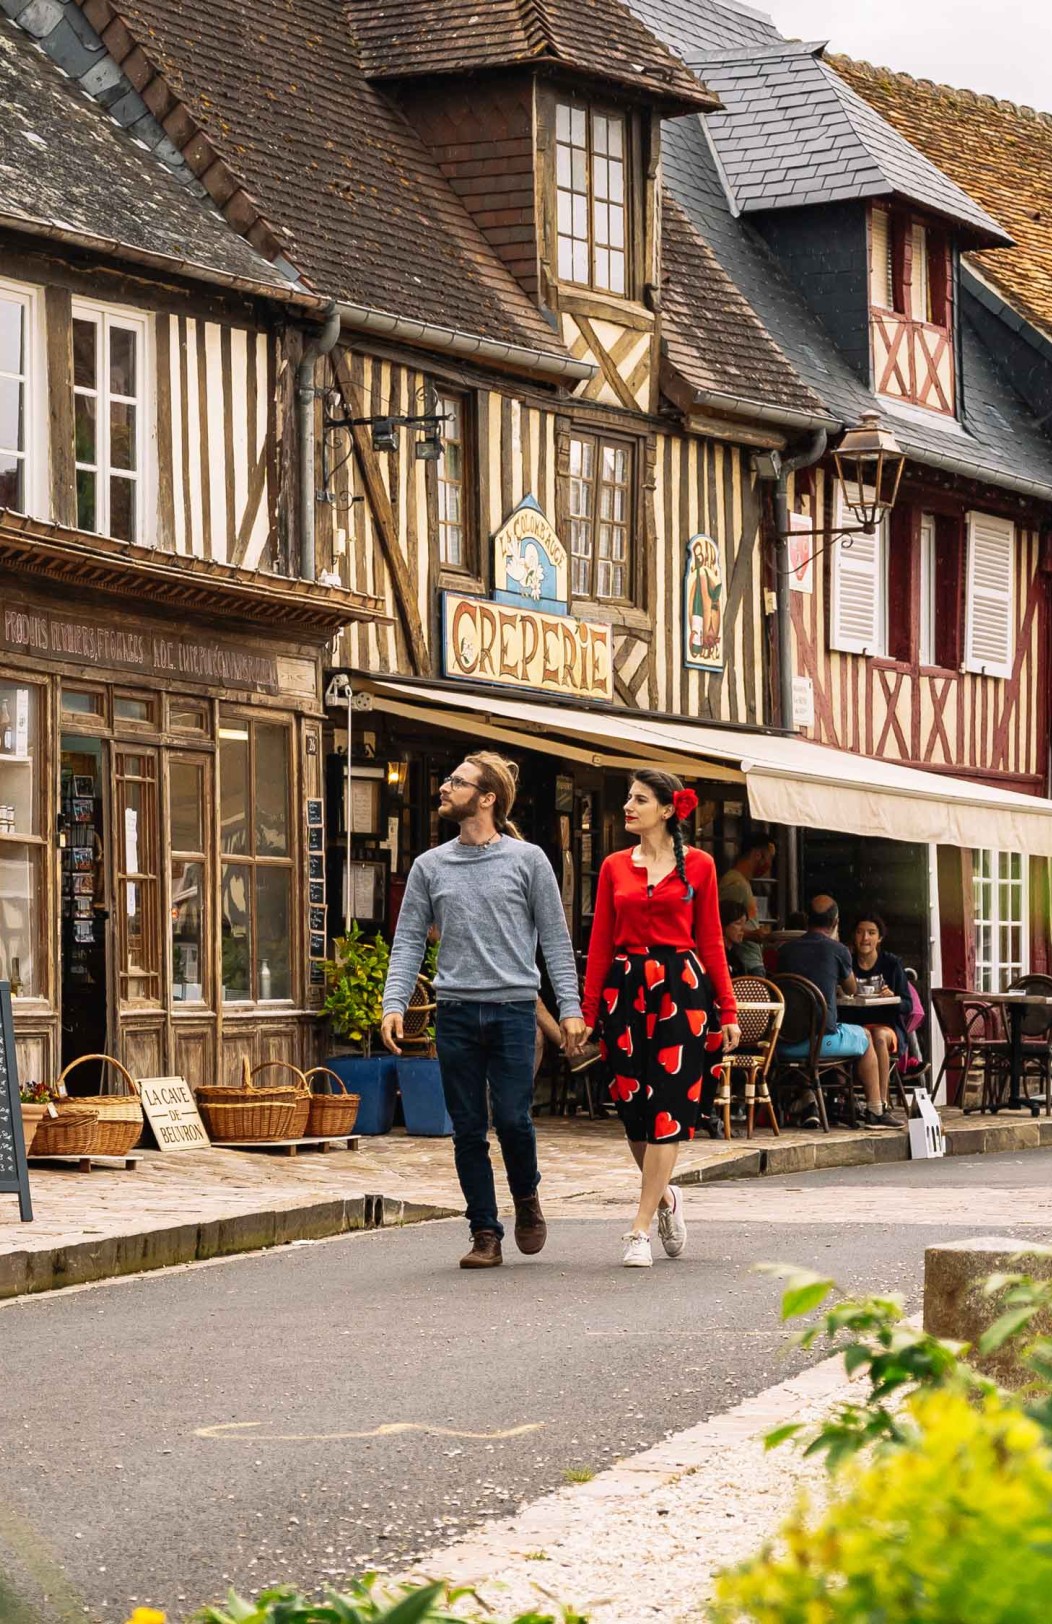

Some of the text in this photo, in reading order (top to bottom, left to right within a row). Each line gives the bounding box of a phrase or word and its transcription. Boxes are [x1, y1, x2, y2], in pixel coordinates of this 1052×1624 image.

[4, 610, 49, 650] PRODUITS
[144, 1086, 190, 1106] LA CAVE
[168, 1109, 182, 1122] DE
[159, 1124, 204, 1144] BEUVRON
